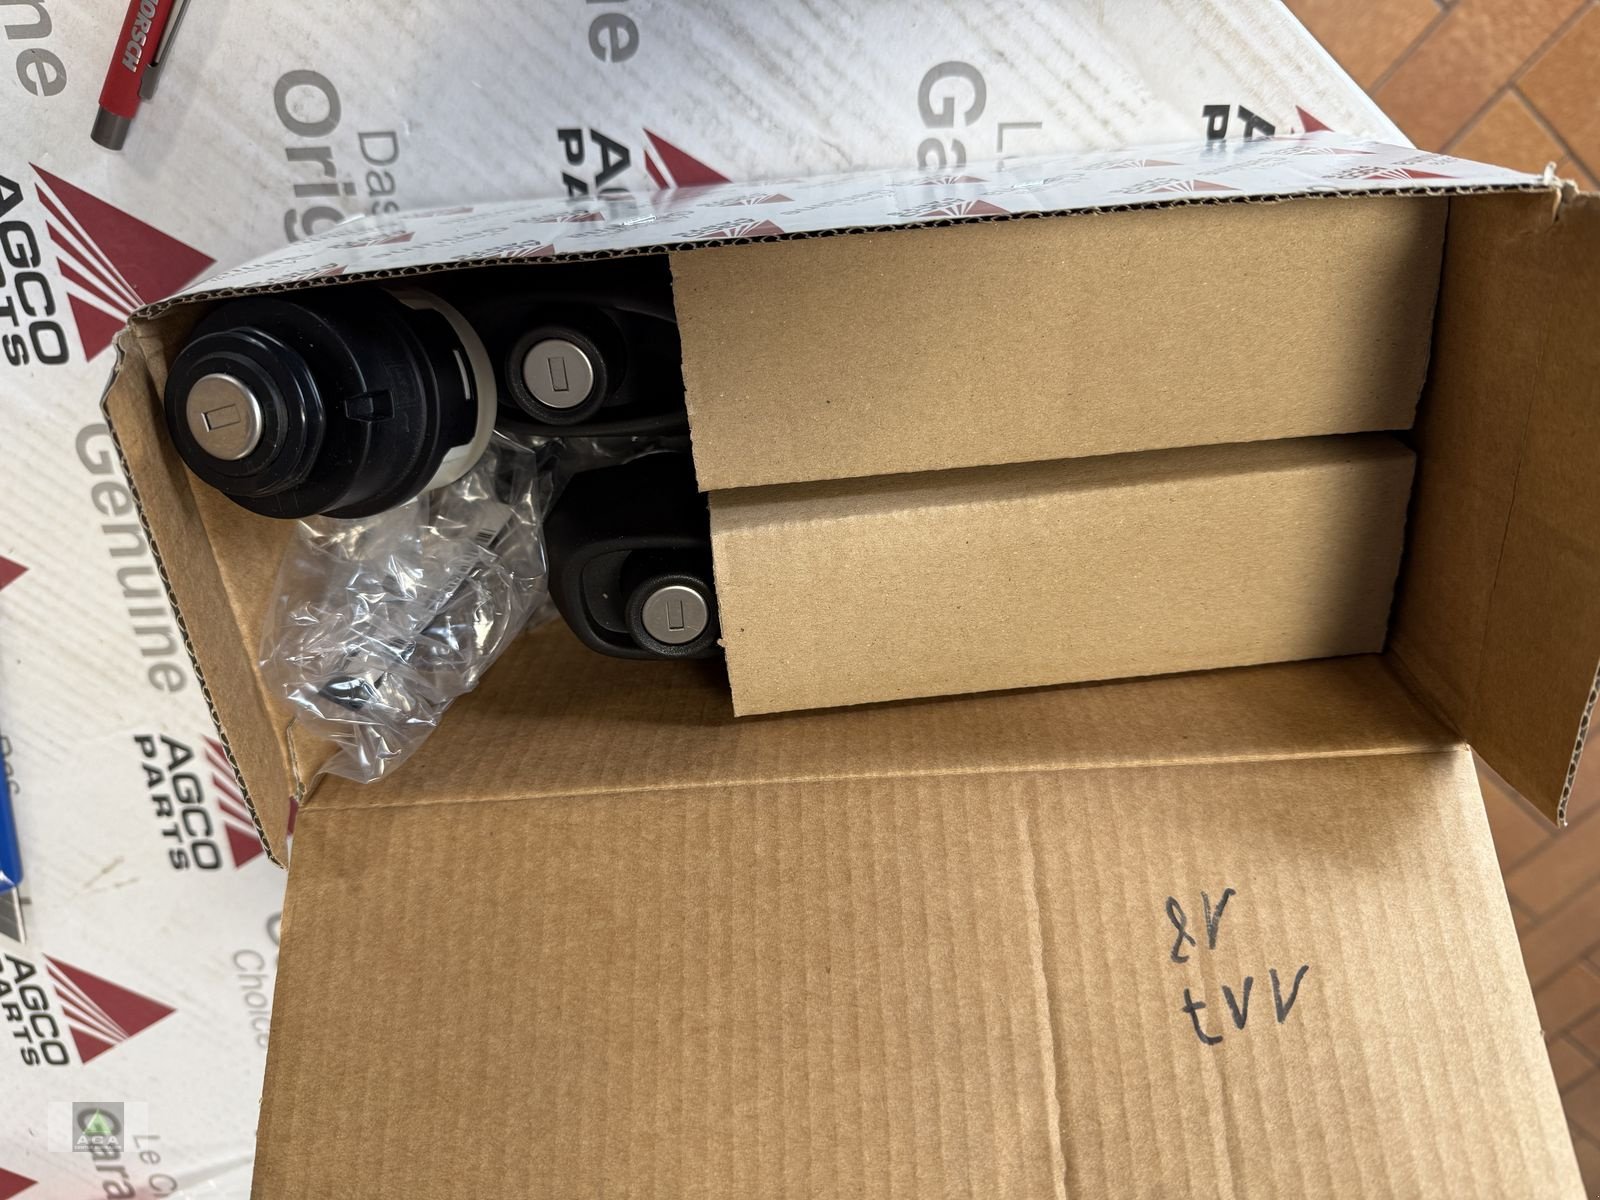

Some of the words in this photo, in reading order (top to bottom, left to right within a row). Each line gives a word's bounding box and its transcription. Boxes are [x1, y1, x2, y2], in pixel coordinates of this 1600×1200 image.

[0, 174, 70, 366] AGCO
[75, 423, 188, 694] Genuine
[133, 735, 190, 870] PARTS
[160, 734, 222, 870] AGCO
[4, 952, 70, 1066] AGCO
